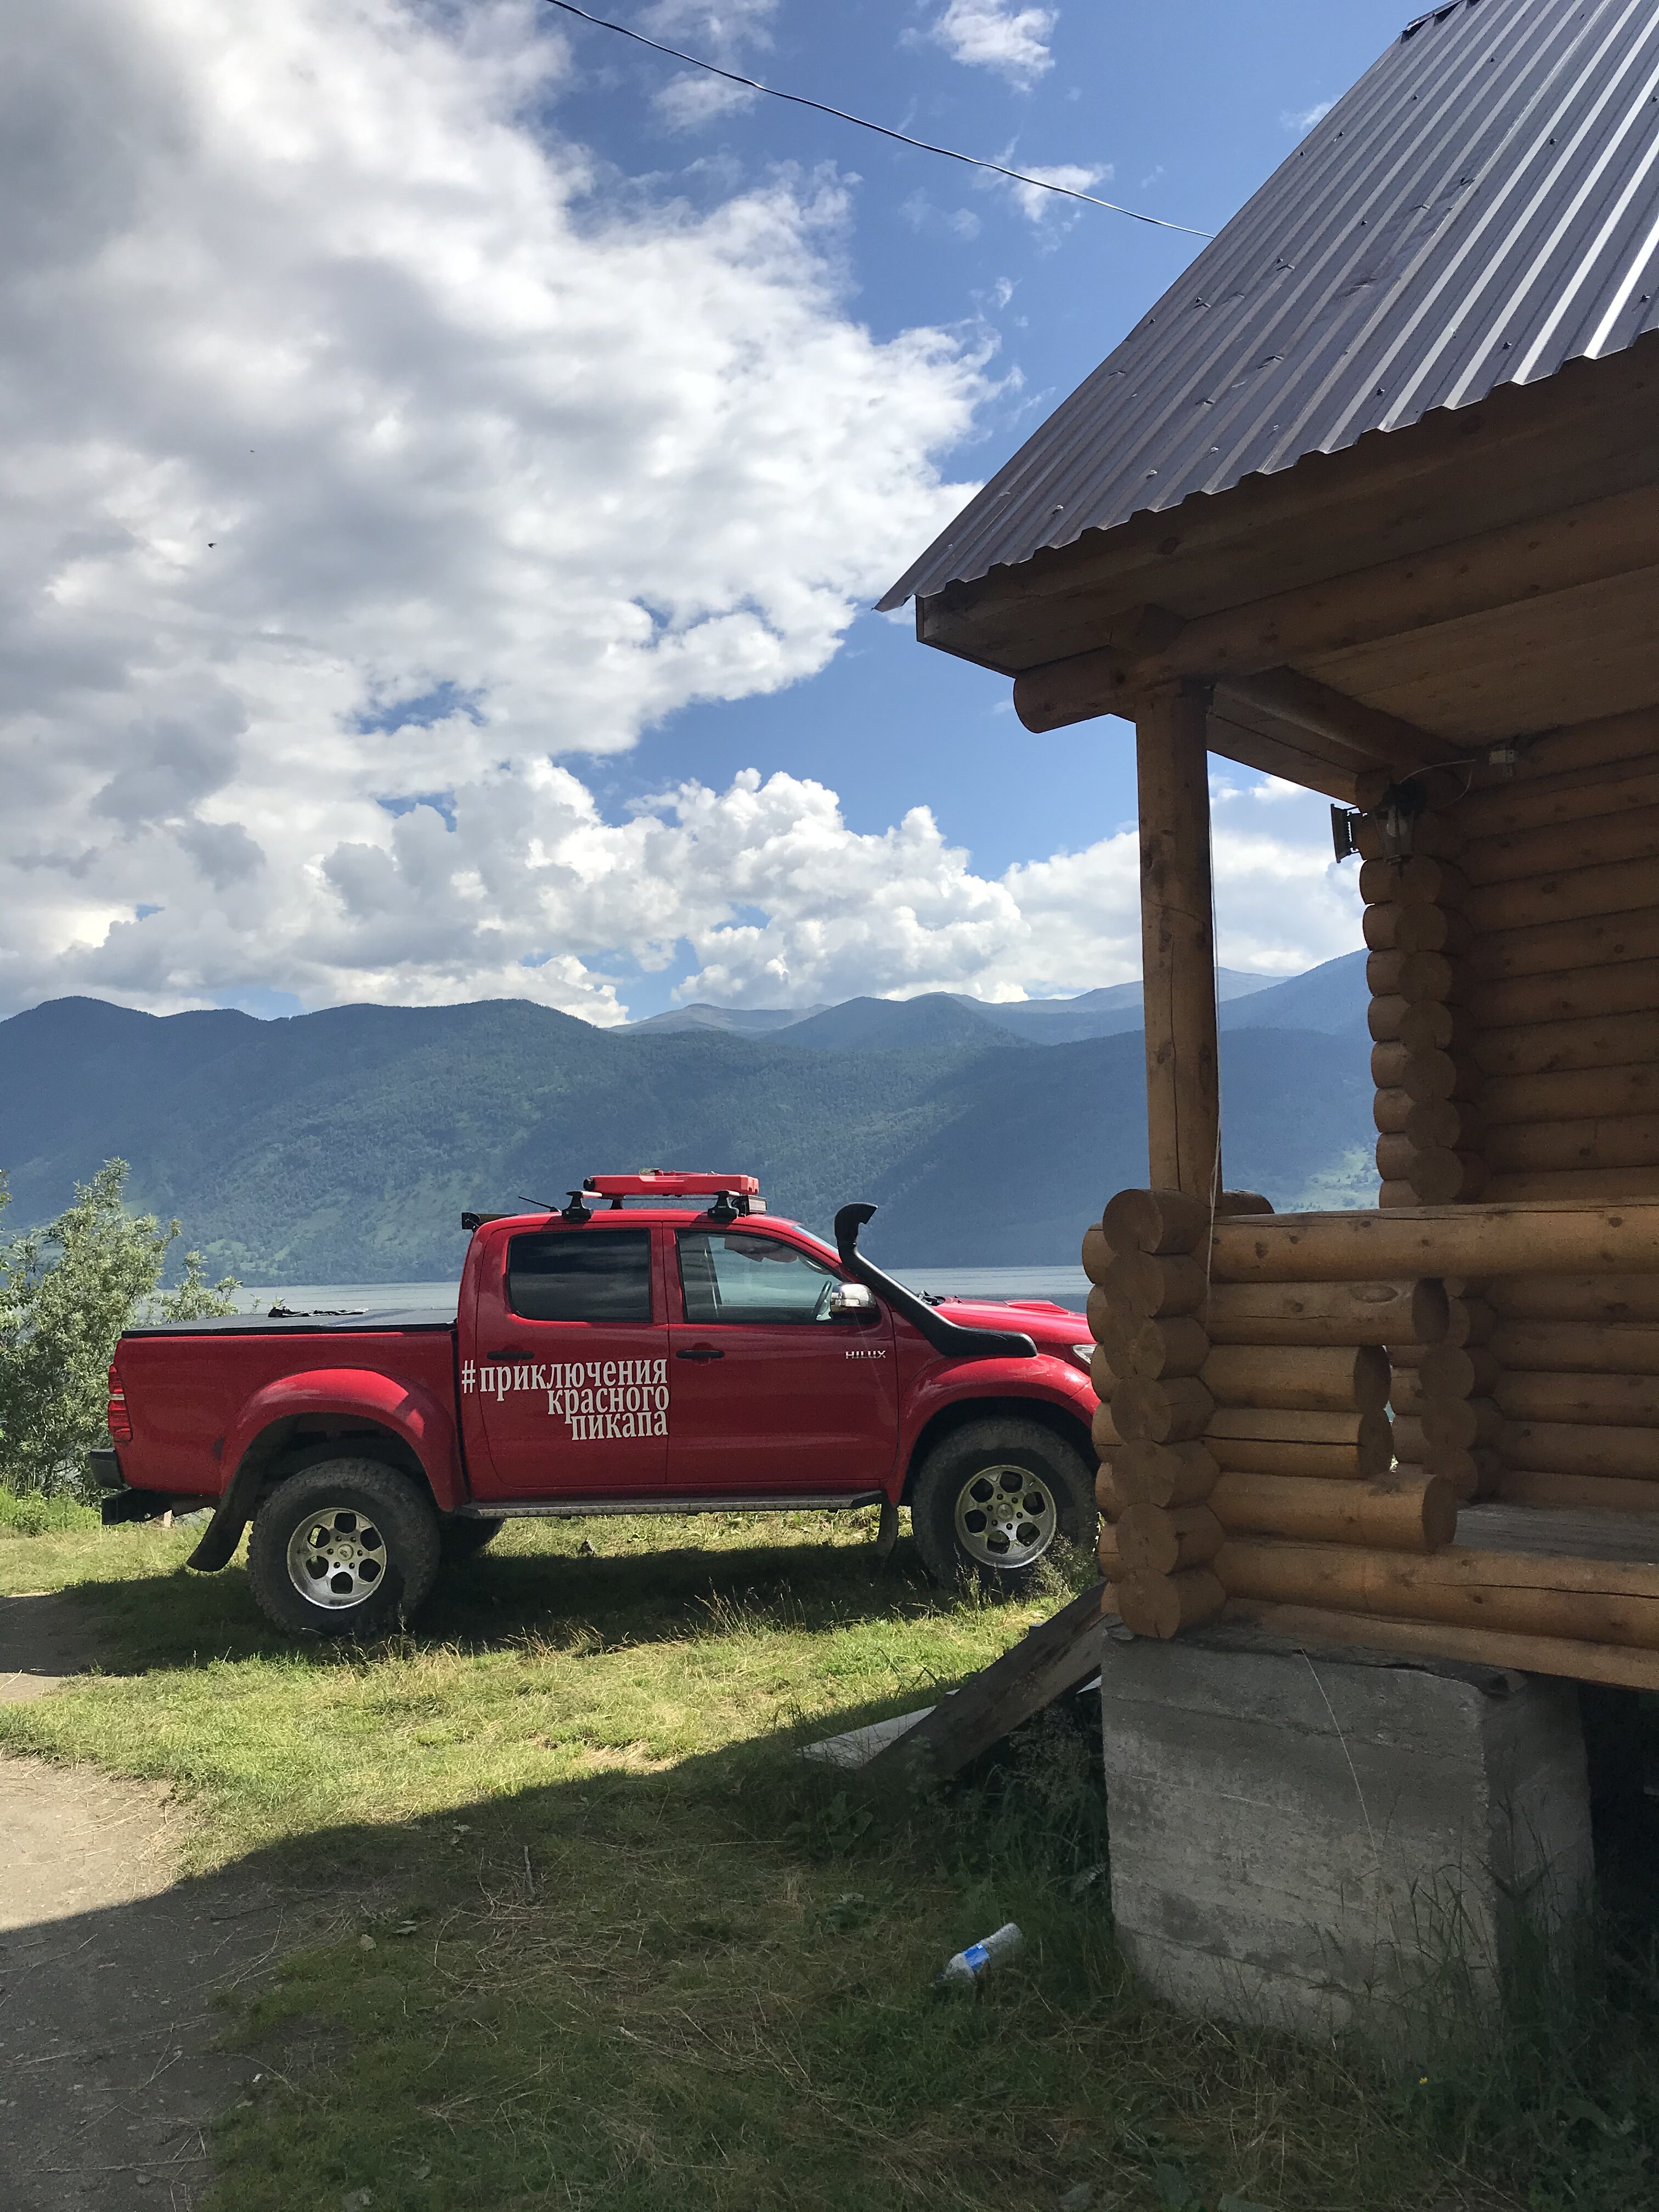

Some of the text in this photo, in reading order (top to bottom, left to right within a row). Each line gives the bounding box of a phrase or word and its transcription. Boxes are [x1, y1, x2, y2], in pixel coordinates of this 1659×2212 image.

[845, 1350, 887, 1359] HILUX
[461, 1359, 668, 1402] #приключения
[547, 1386, 669, 1424] красного
[571, 1410, 668, 1441] пикапа
